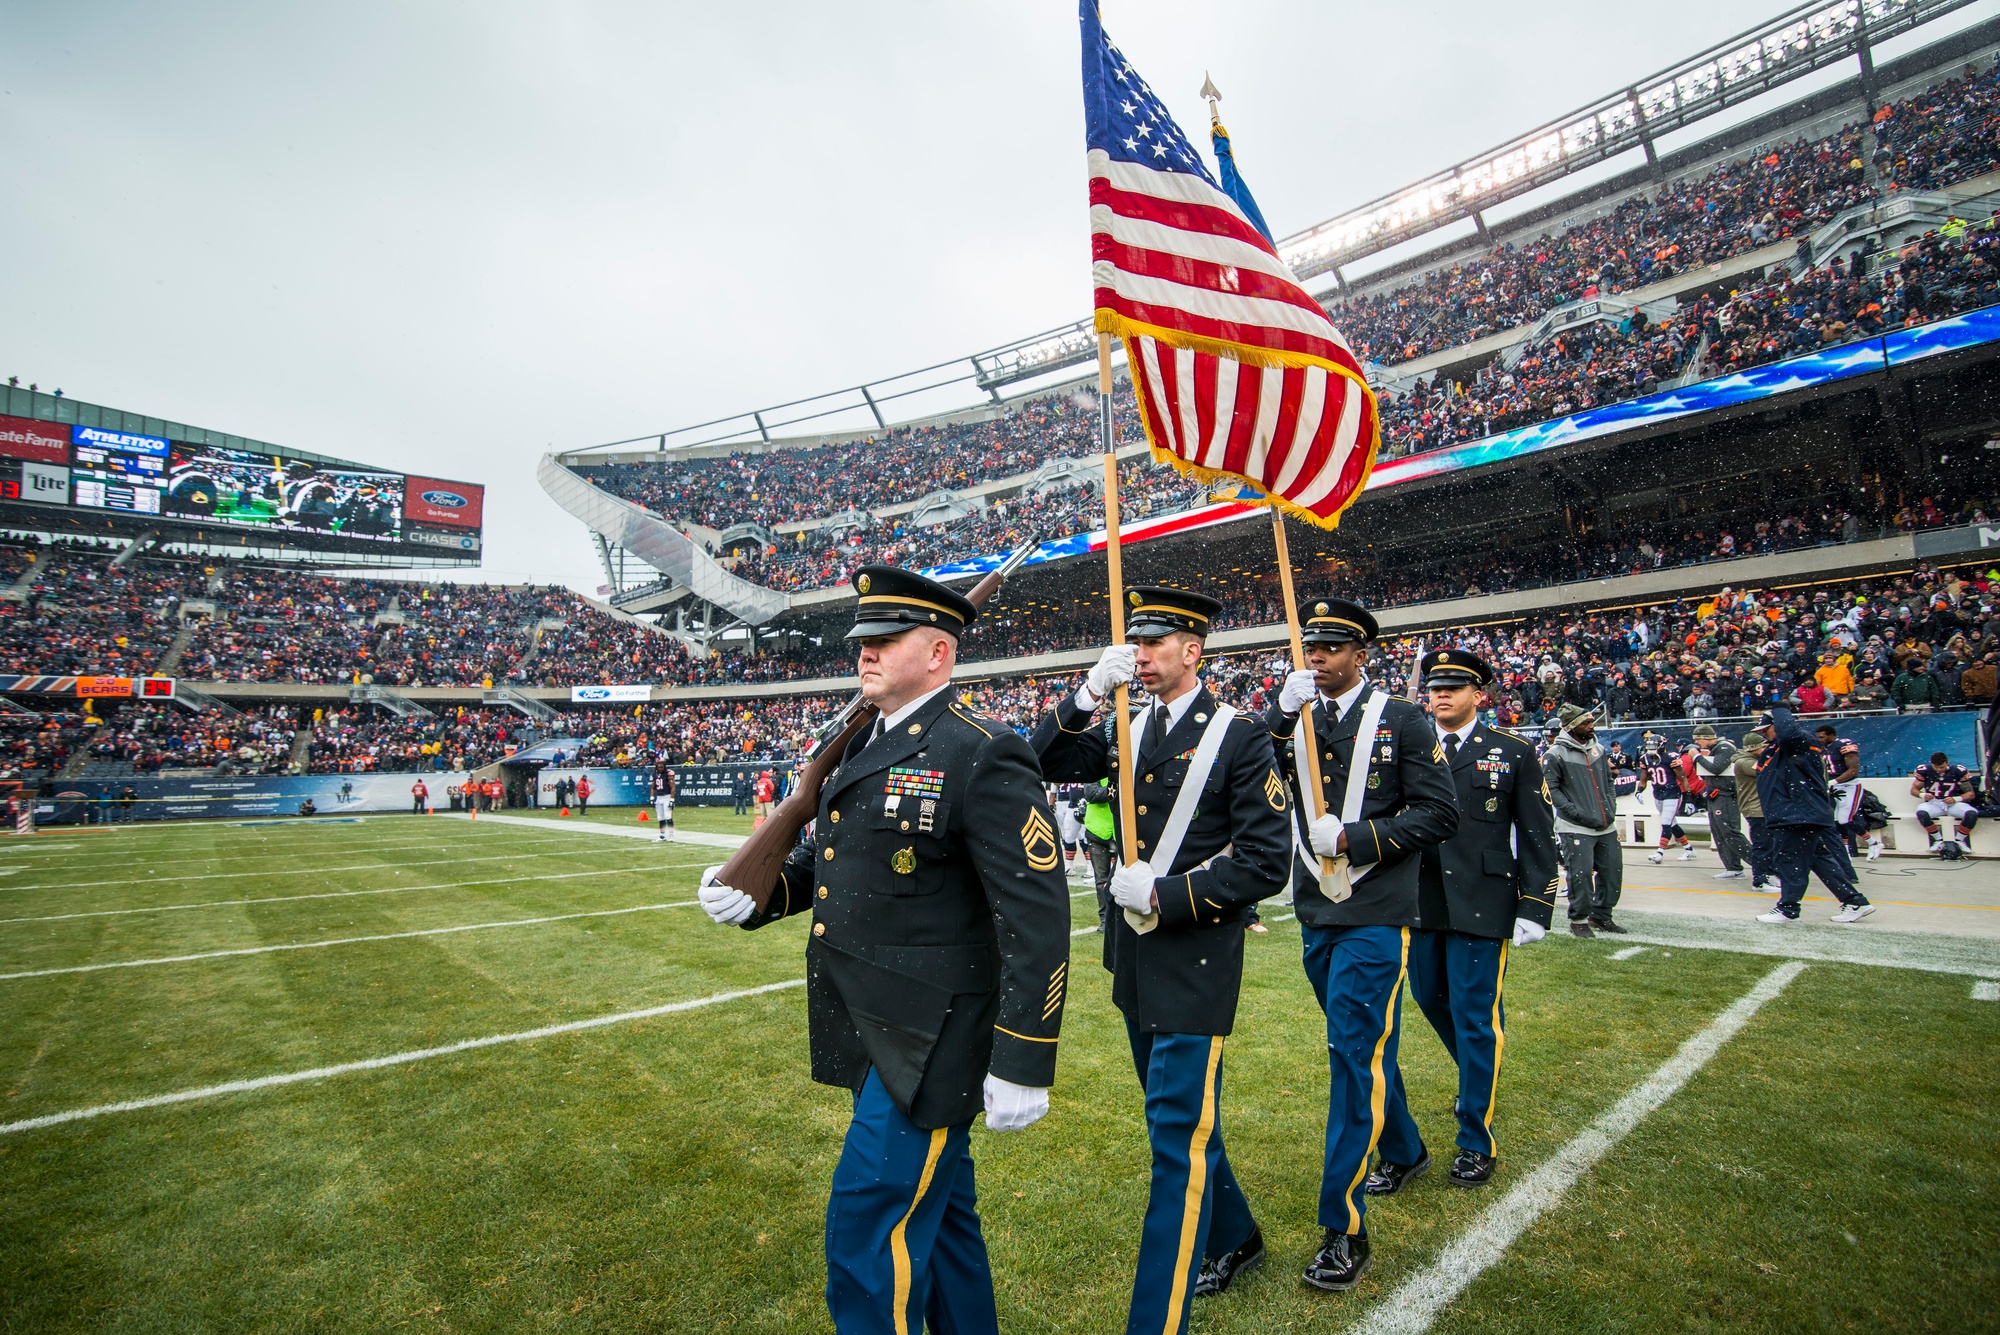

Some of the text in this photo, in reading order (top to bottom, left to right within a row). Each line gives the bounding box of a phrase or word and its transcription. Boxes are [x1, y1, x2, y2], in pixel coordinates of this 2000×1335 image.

[1888, 203, 1909, 216] 336
[1561, 217, 1576, 228] 435
[1582, 304, 1596, 315] 335
[79, 428, 165, 450] ATHLETICO
[33, 474, 65, 491] Lite
[0, 481, 19, 498] 3
[429, 493, 459, 506] Ford
[409, 532, 457, 546] CHASE
[144, 680, 171, 696] 34
[583, 690, 605, 698] Ford
[1754, 684, 1764, 697] 9
[1647, 767, 1667, 785] 30
[655, 779, 664, 789] 91
[1928, 781, 1956, 797] 47
[680, 787, 696, 796] HALL
[706, 787, 733, 796] FAMERS
